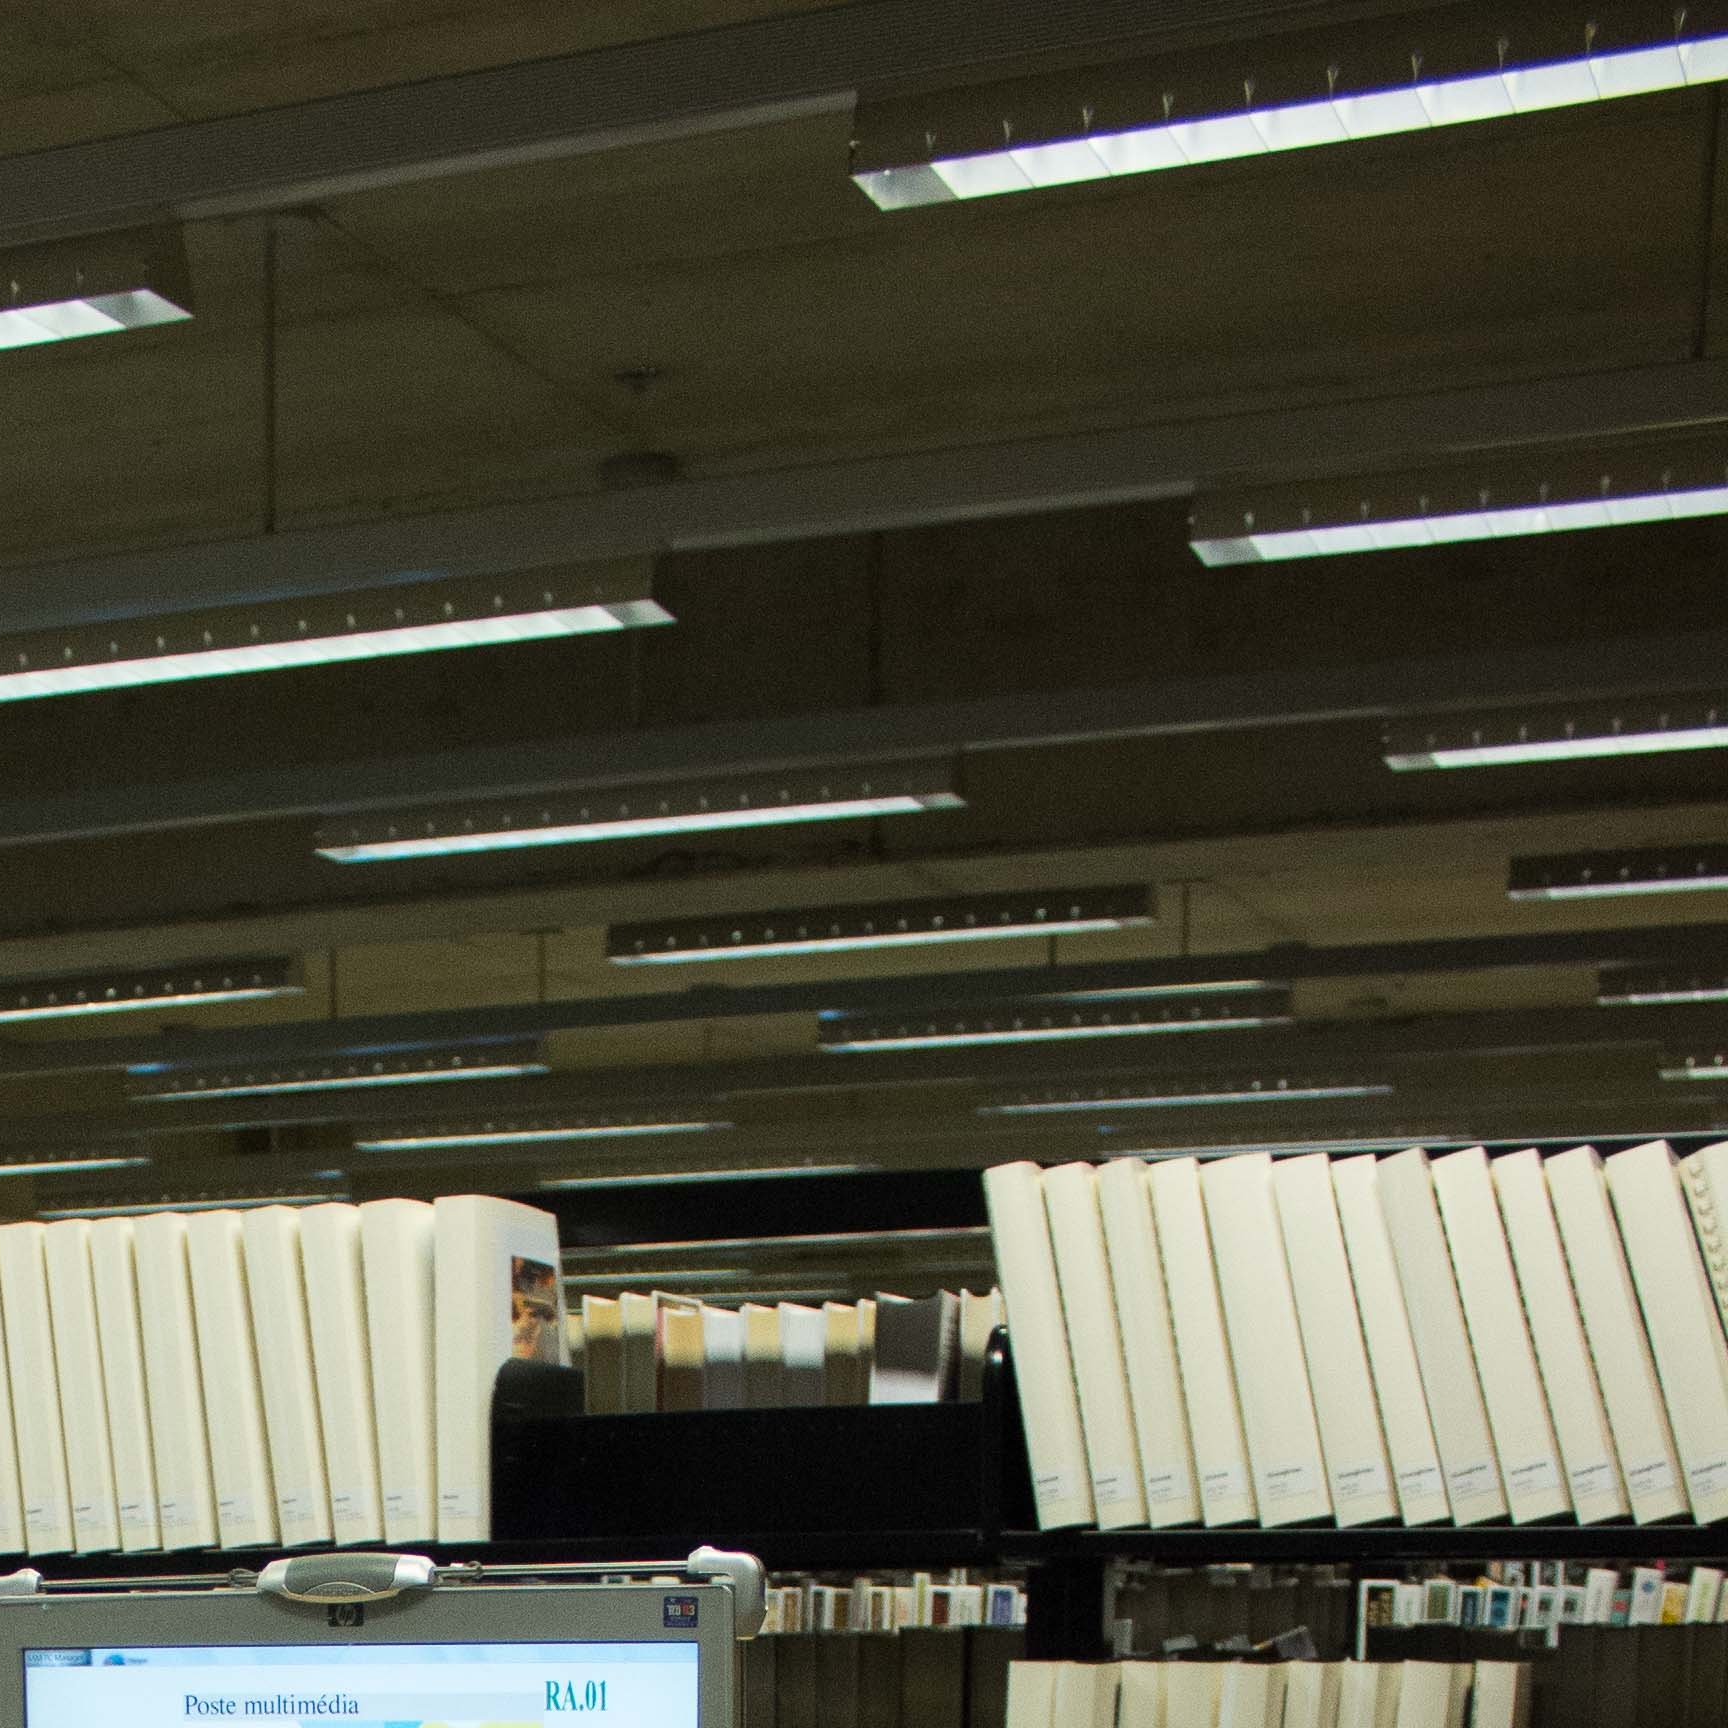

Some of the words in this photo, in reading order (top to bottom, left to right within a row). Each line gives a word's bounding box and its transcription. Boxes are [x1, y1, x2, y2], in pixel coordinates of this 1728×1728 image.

[184, 1694, 236, 1715] Poste
[244, 1692, 360, 1716] multimédia
[545, 1680, 608, 1711] RA.01
